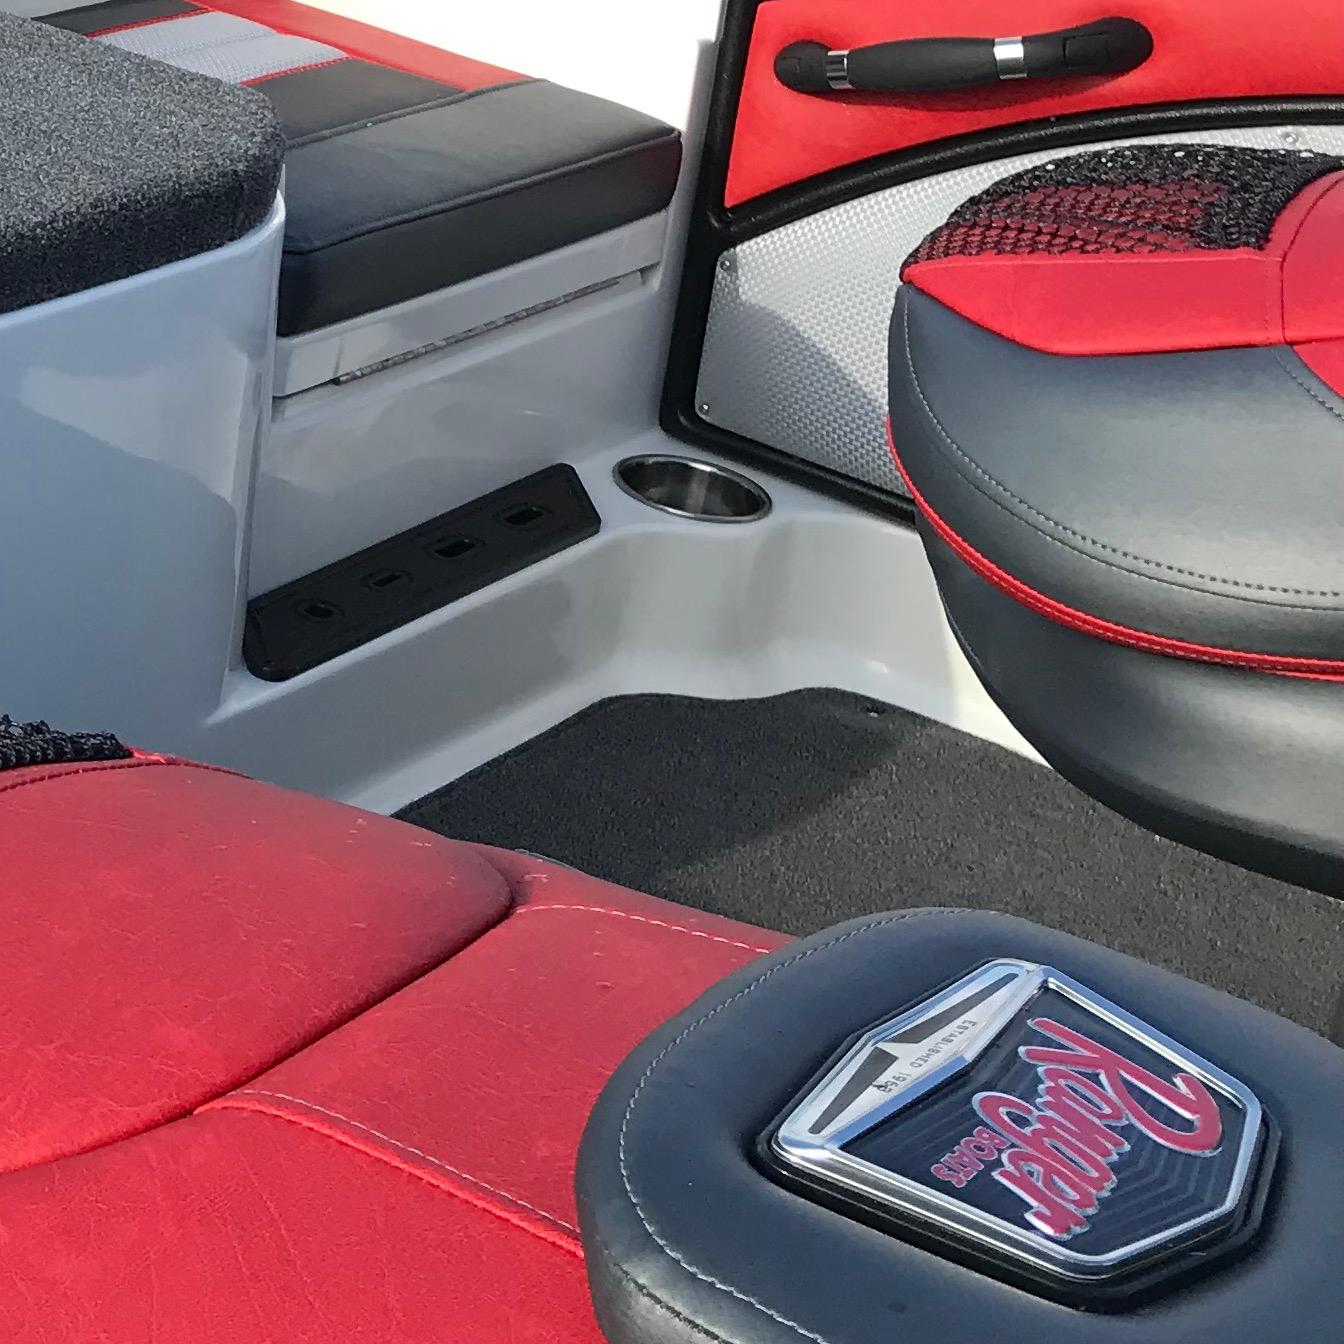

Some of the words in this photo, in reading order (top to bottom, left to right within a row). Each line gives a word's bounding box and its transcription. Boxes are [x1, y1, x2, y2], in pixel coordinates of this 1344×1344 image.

[909, 1019, 978, 1068] ESTABLISHED
[929, 1125, 1011, 1189] BOATS
[971, 1016, 1223, 1240] Ranger
